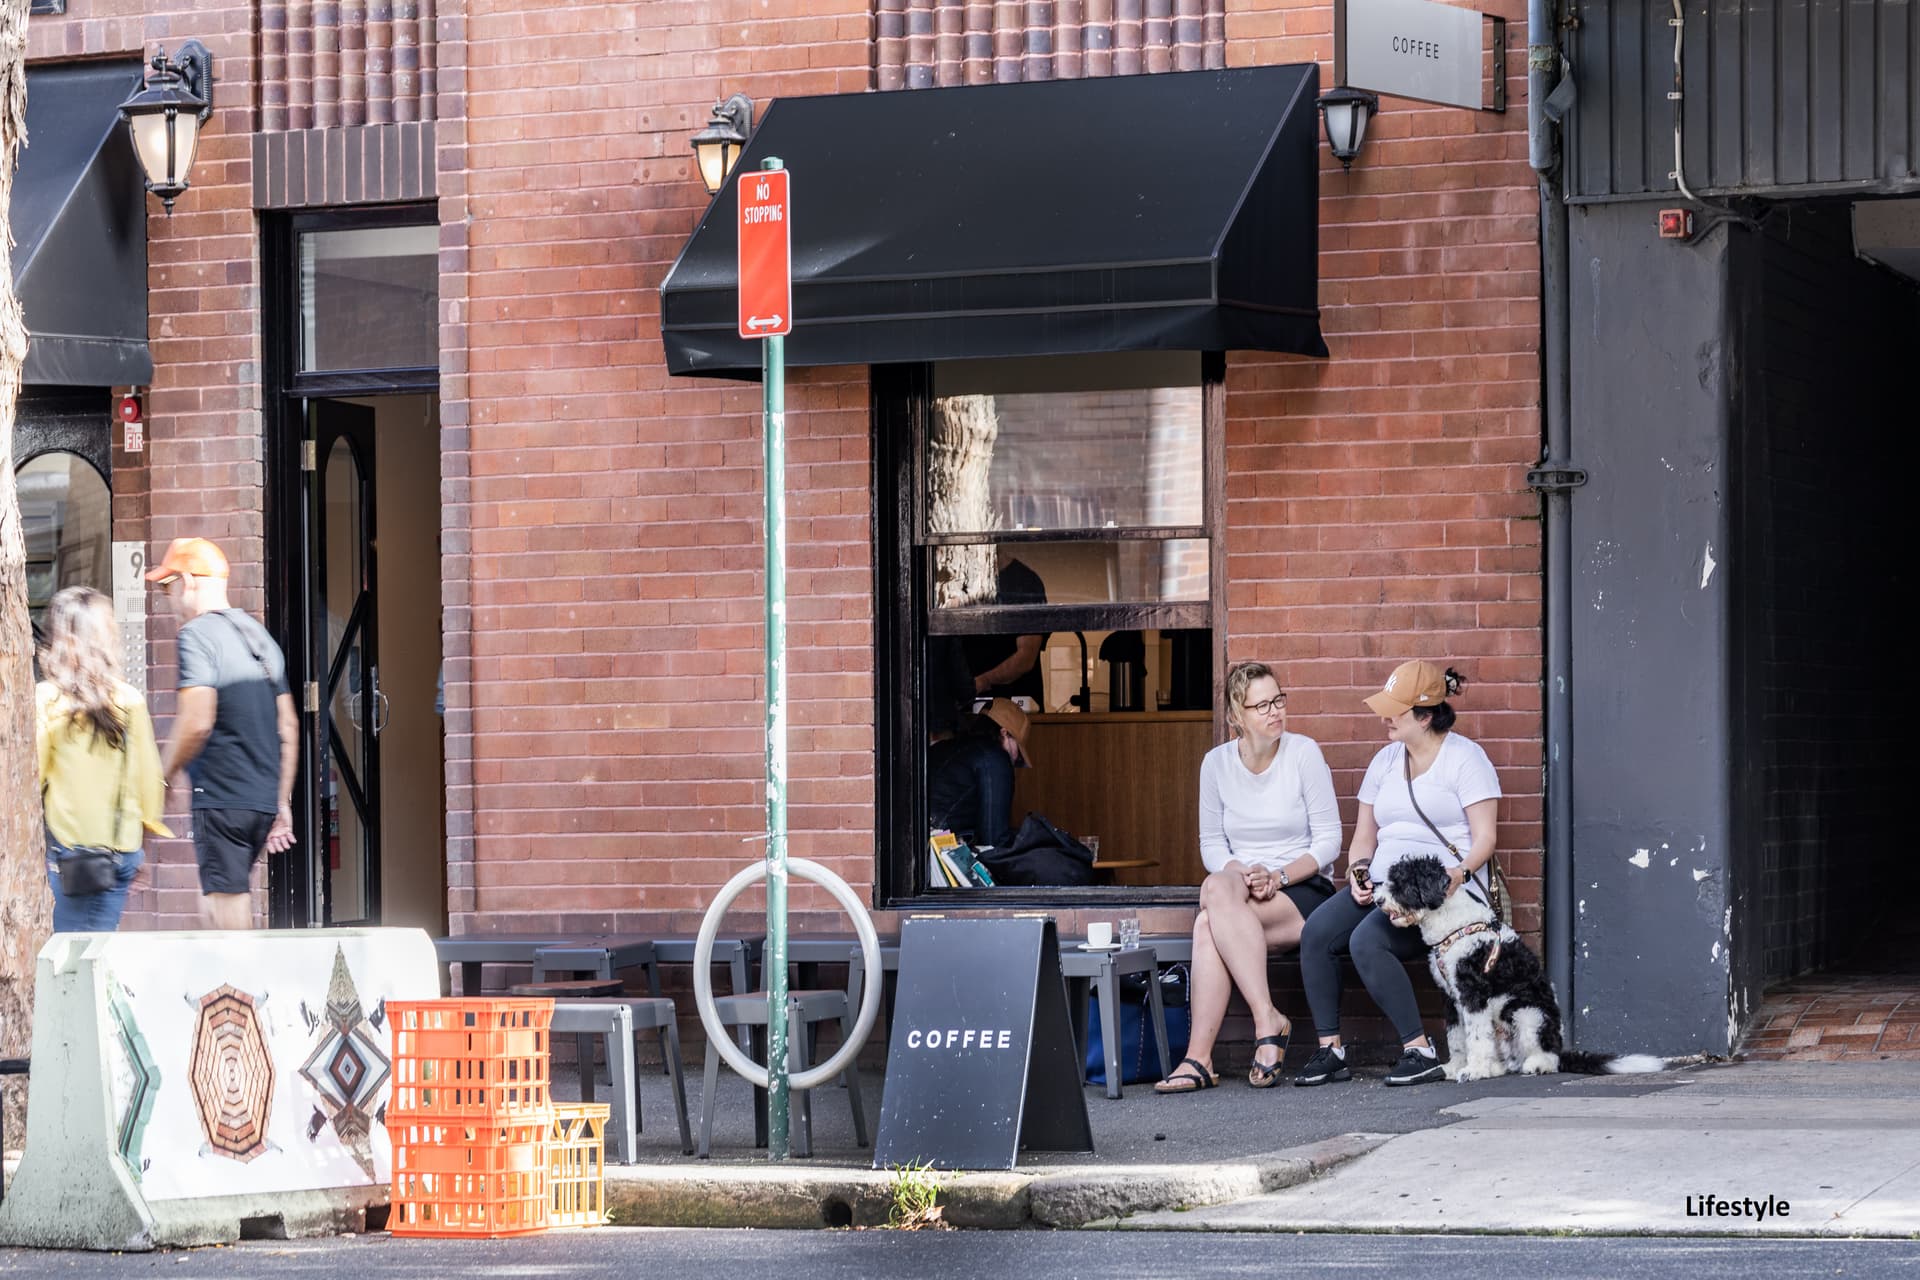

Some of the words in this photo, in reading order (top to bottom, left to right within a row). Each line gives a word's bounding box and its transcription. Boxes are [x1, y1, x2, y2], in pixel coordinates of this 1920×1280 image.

[1393, 36, 1439, 59] COFFEE
[756, 183, 770, 201] NO
[744, 204, 783, 224] STOPPING
[907, 1029, 1012, 1049] COFFEE
